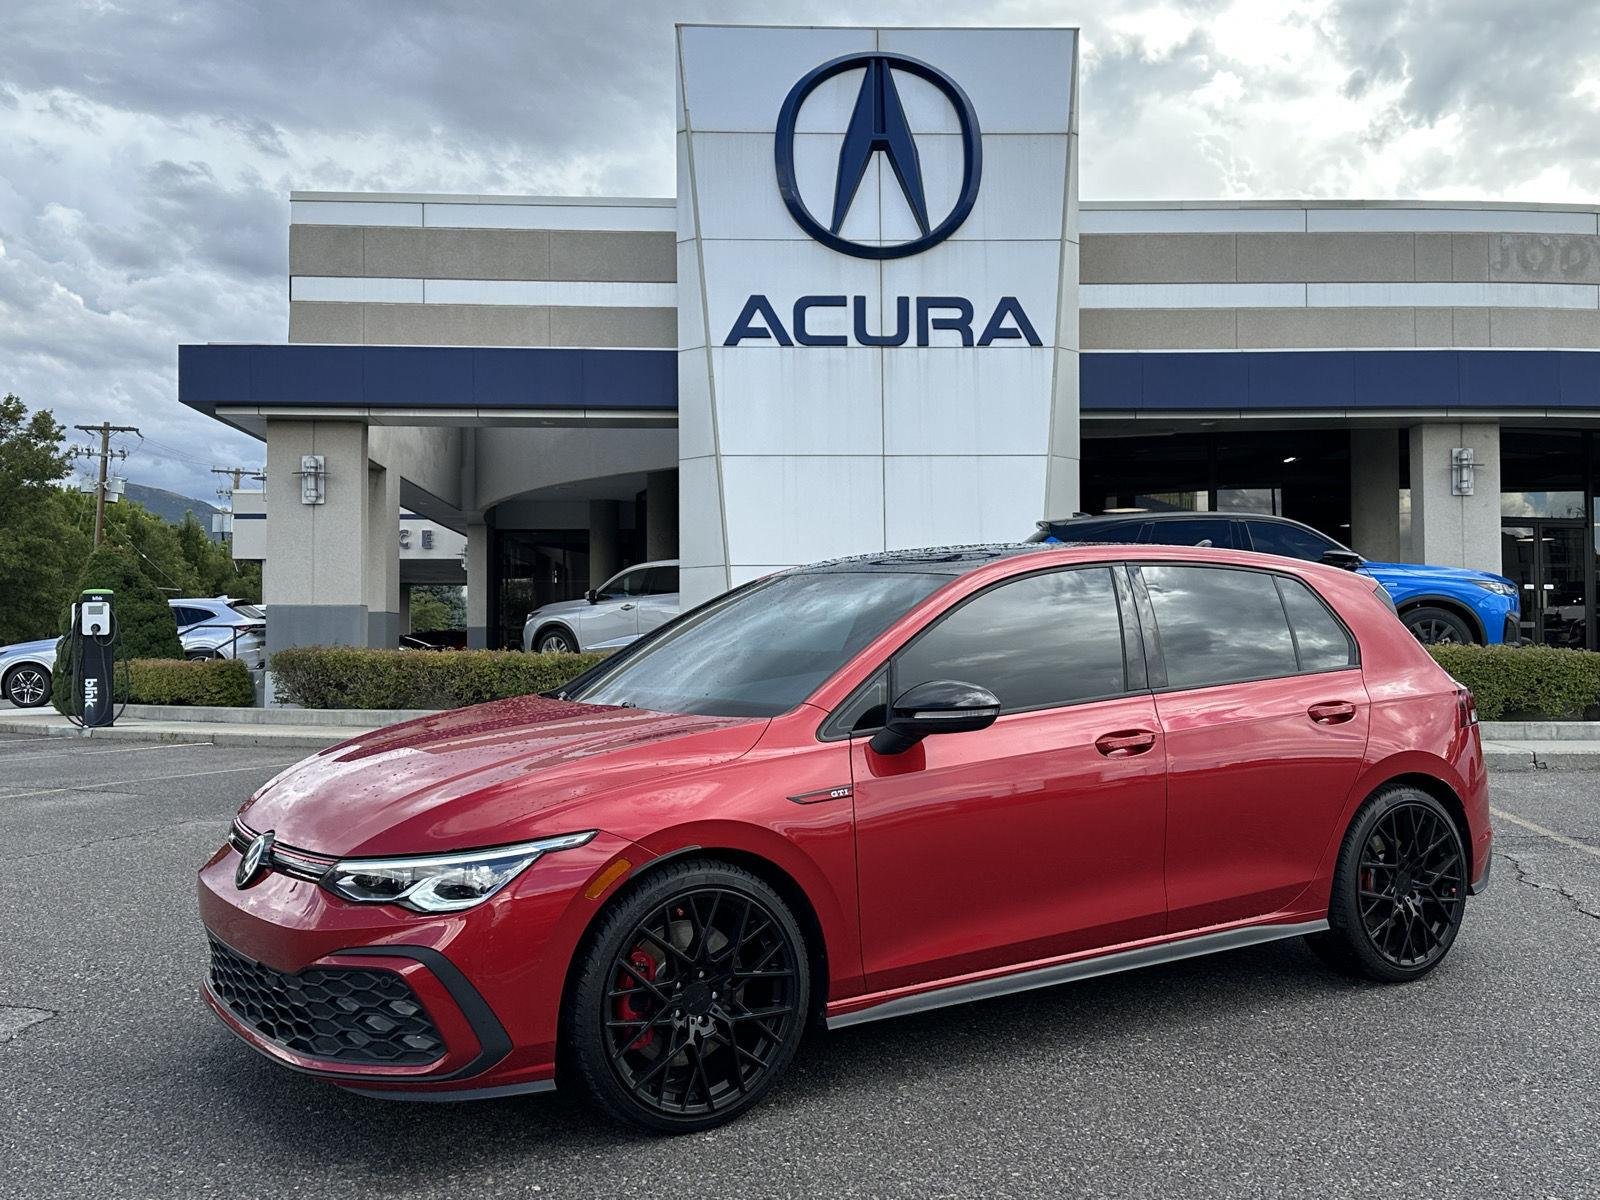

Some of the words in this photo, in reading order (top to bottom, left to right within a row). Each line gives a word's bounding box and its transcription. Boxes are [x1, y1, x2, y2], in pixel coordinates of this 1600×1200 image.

[723, 294, 1044, 347] ACURA
[85, 678, 98, 708] blink
[831, 788, 849, 798] GTI
